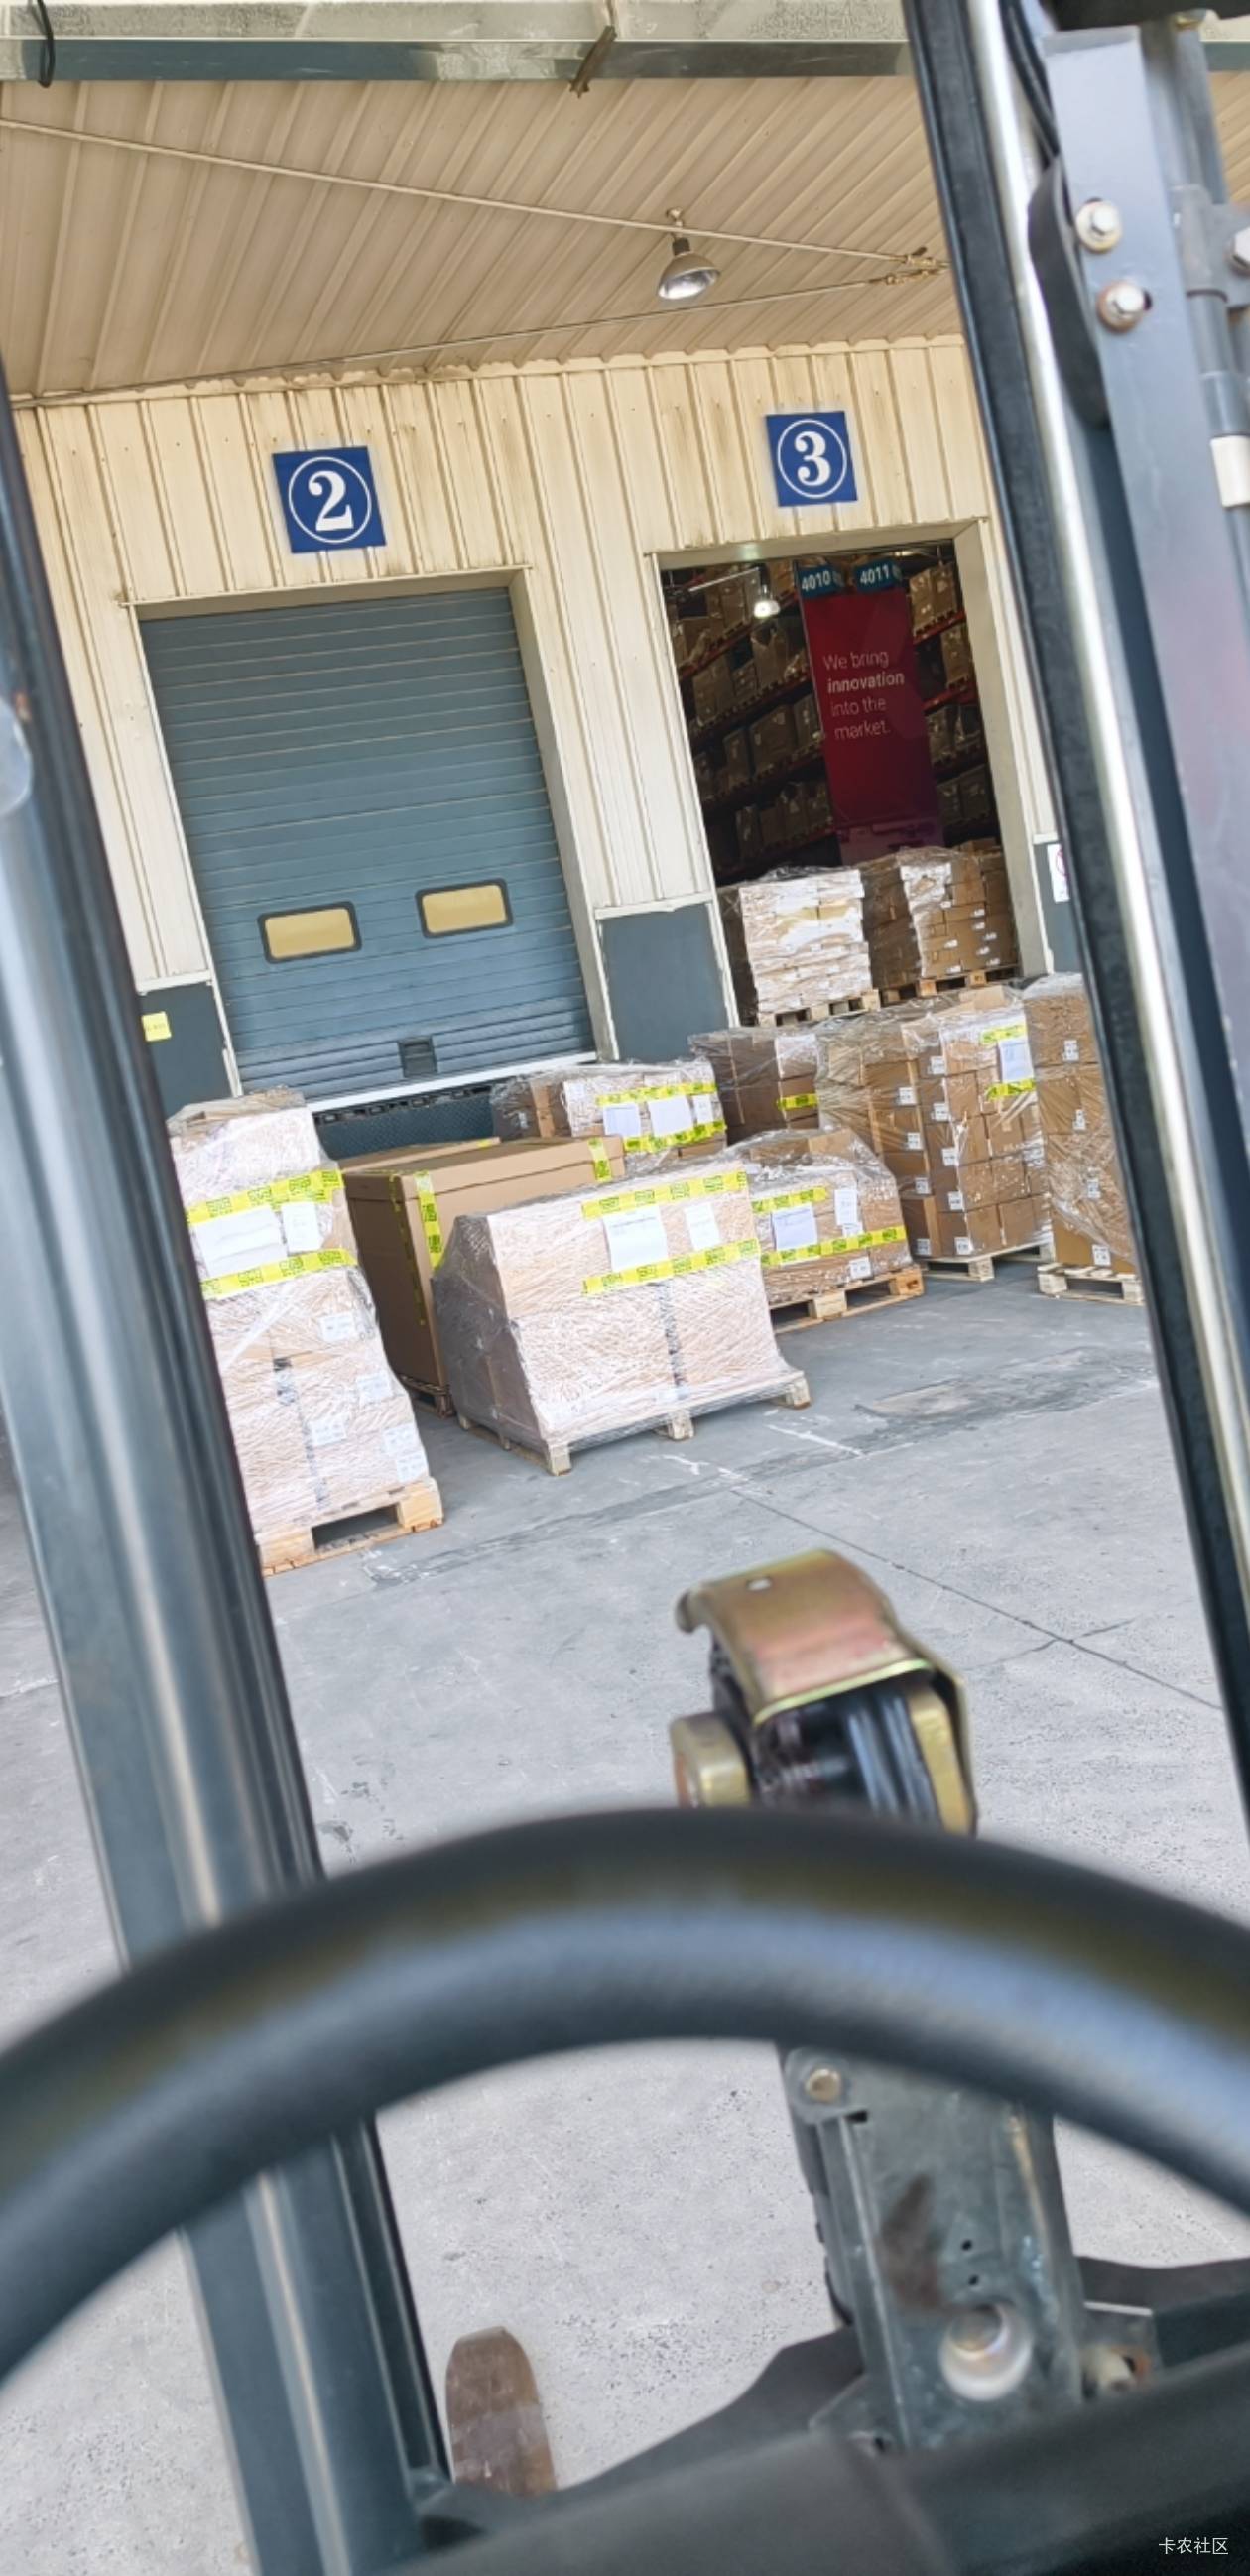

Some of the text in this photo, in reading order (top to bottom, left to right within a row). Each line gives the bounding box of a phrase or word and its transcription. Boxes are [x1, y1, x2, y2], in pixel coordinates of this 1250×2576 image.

[794, 430, 832, 487] 3
[308, 469, 354, 532] 2
[801, 569, 832, 592] 4010
[859, 563, 891, 585] 4011
[822, 650, 890, 671] We bring
[827, 671, 905, 694] innovation
[830, 695, 887, 717] into the
[834, 719, 892, 741] market.
